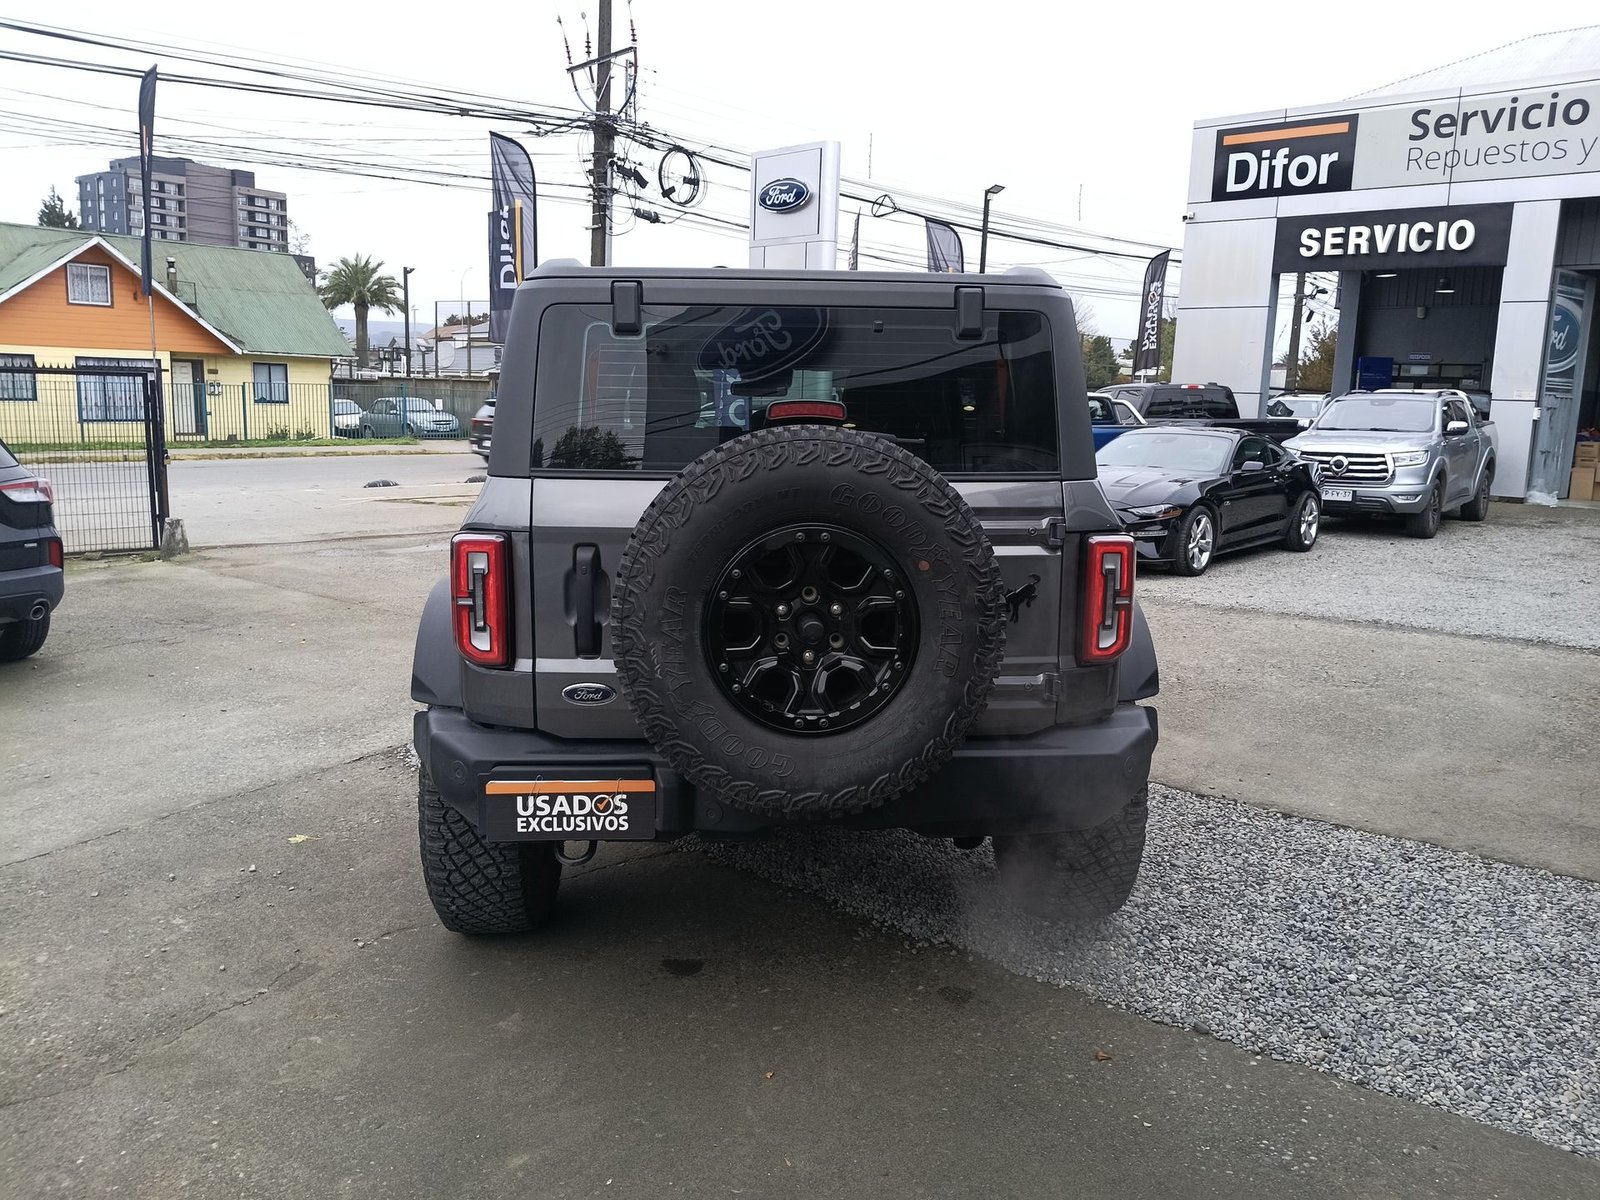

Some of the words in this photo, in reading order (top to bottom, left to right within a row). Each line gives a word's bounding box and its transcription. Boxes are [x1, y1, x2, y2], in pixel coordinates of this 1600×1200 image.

[1408, 92, 1590, 141] Servicio
[1226, 147, 1339, 193] Difor
[1406, 138, 1568, 176] Repuestos
[1577, 136, 1599, 165] y
[765, 184, 797, 205] Ford
[1299, 219, 1476, 259] SERVICIO
[574, 687, 604, 700] Ford
[516, 794, 628, 816] USADOS
[516, 815, 629, 832] EXCLUSIVOS
